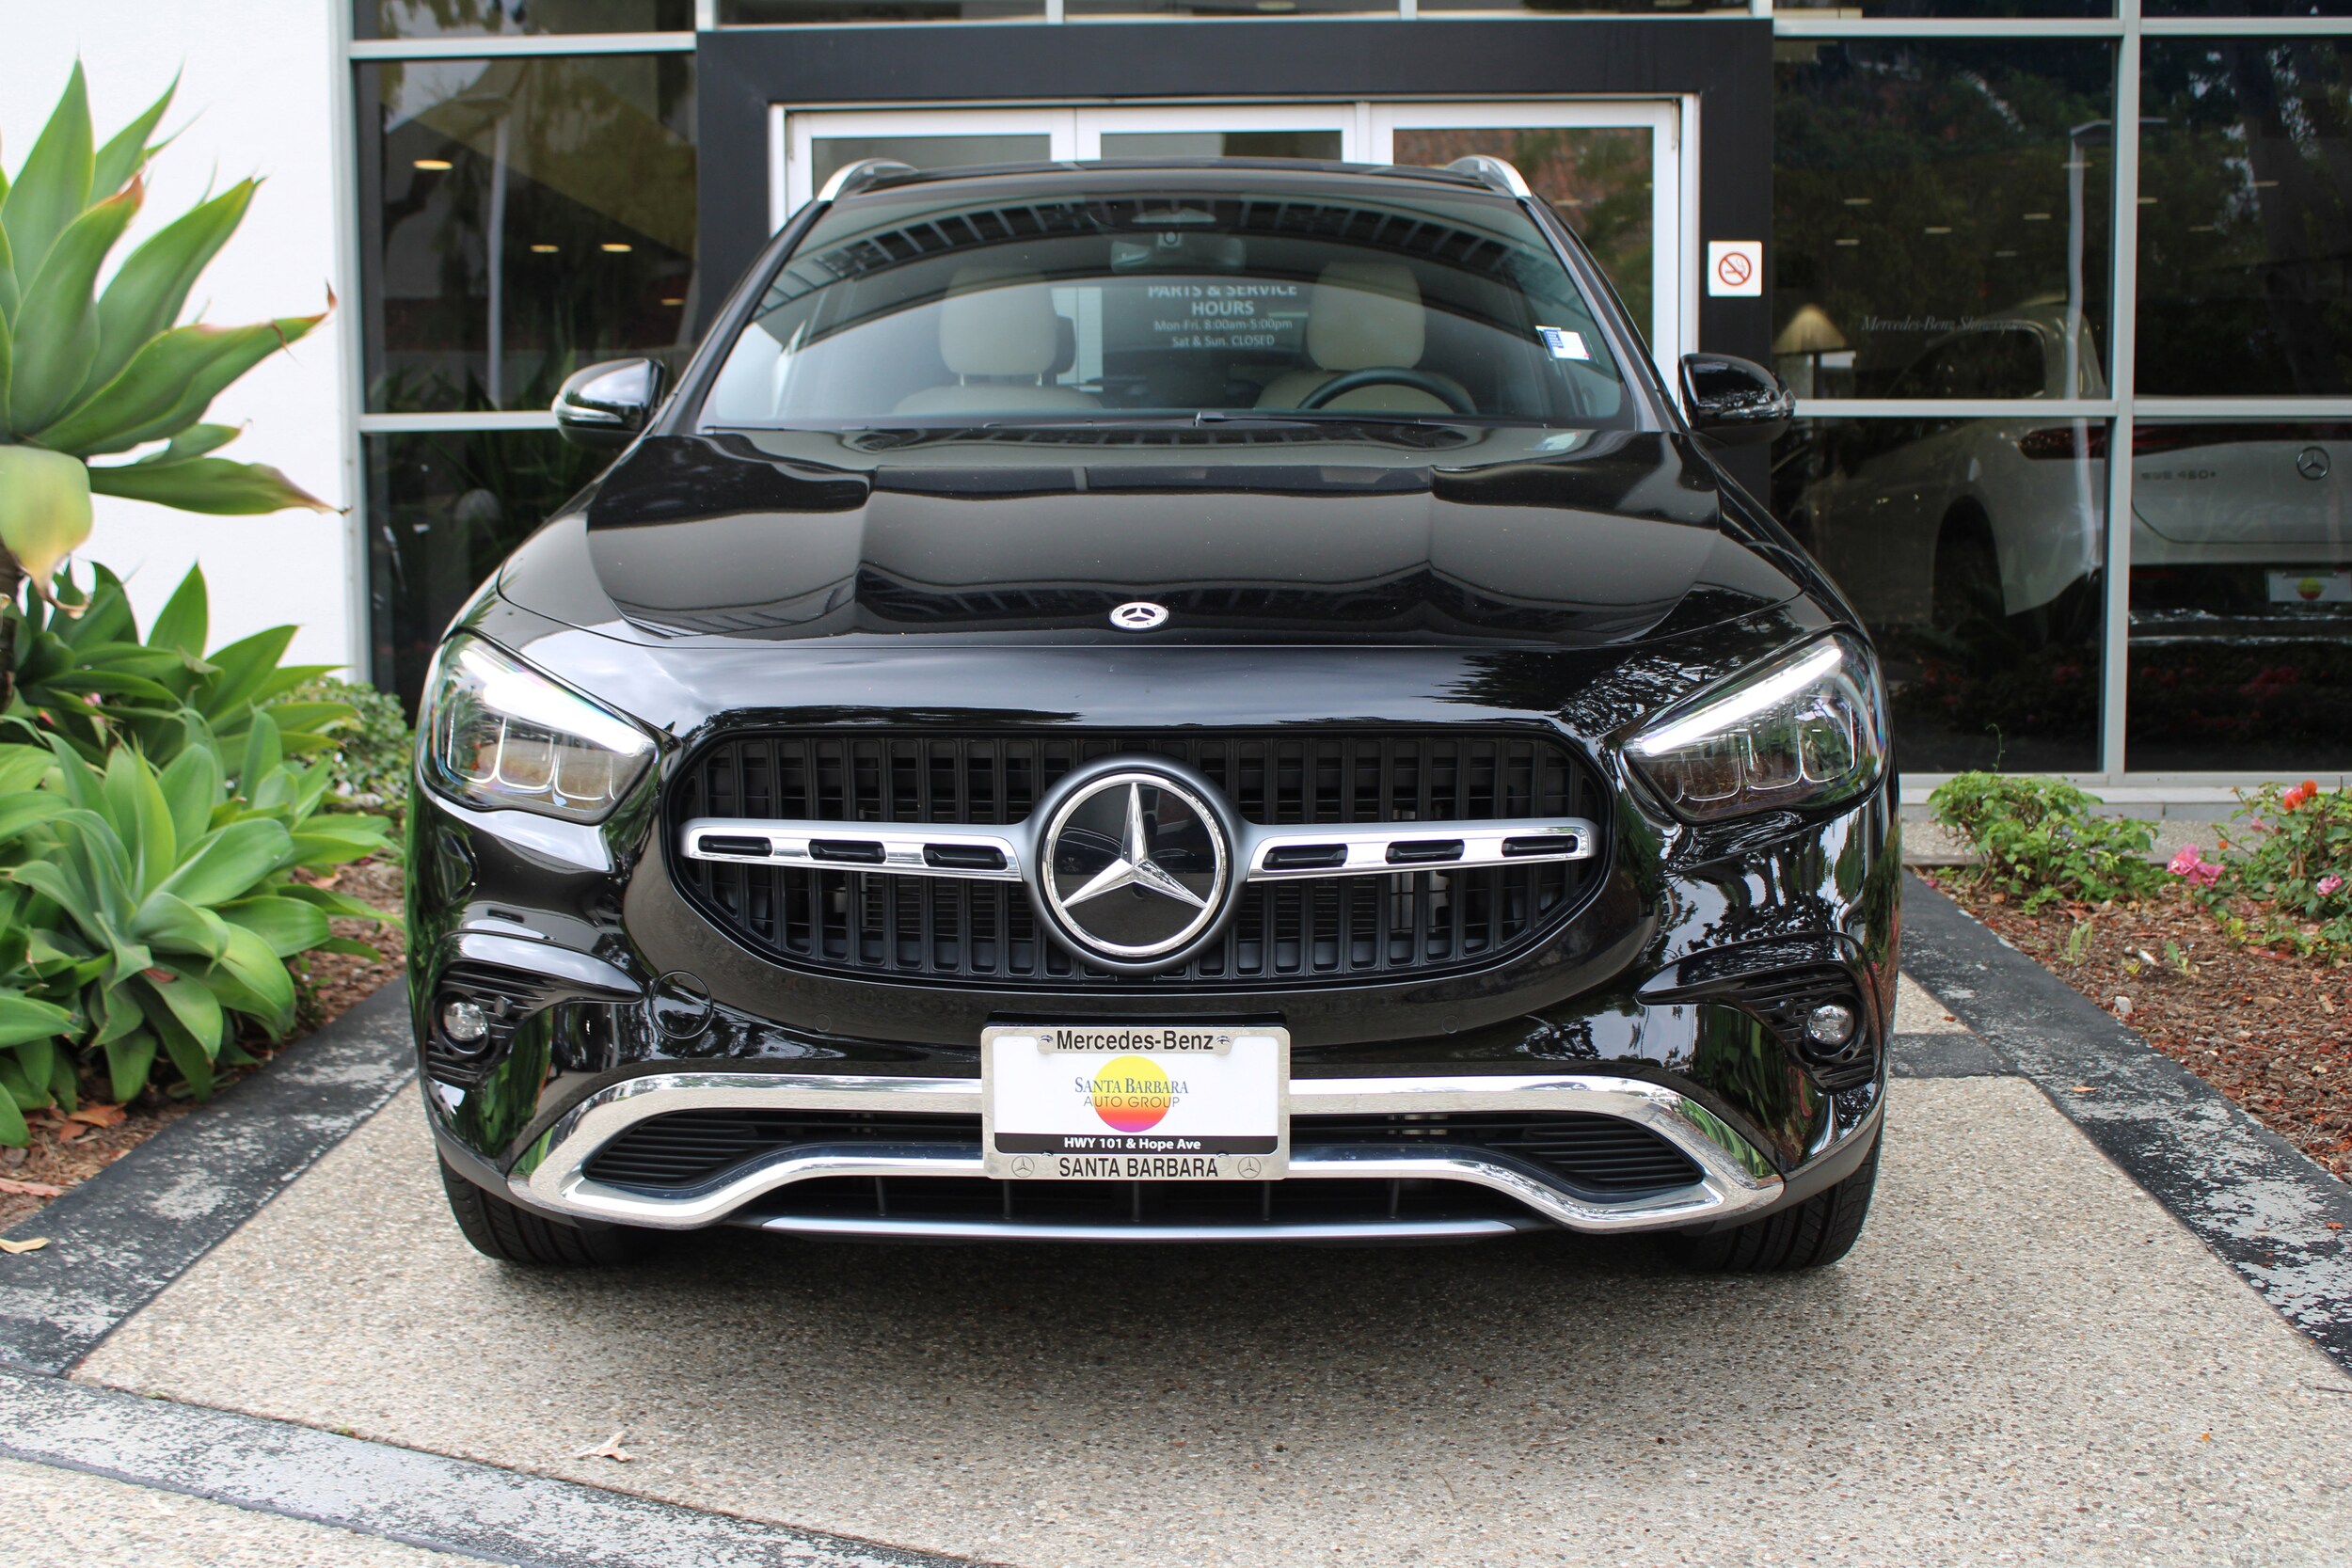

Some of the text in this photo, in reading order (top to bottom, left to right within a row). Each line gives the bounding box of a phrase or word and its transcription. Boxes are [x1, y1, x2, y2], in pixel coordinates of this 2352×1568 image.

[1148, 285, 1297, 298] PARTS & SERVICE
[1191, 300, 1254, 316] HOURS
[1172, 334, 1275, 348] Sat & Sun. CLOSED
[1056, 1030, 1214, 1051] Mercedes-Benz
[1074, 1076, 1189, 1094] SANTA BARBARA
[1083, 1095, 1181, 1108] AUTO GROUP
[1064, 1137, 1201, 1151] HWY 101 & Hope Ave
[1059, 1157, 1218, 1178] SANTA BARBARA
